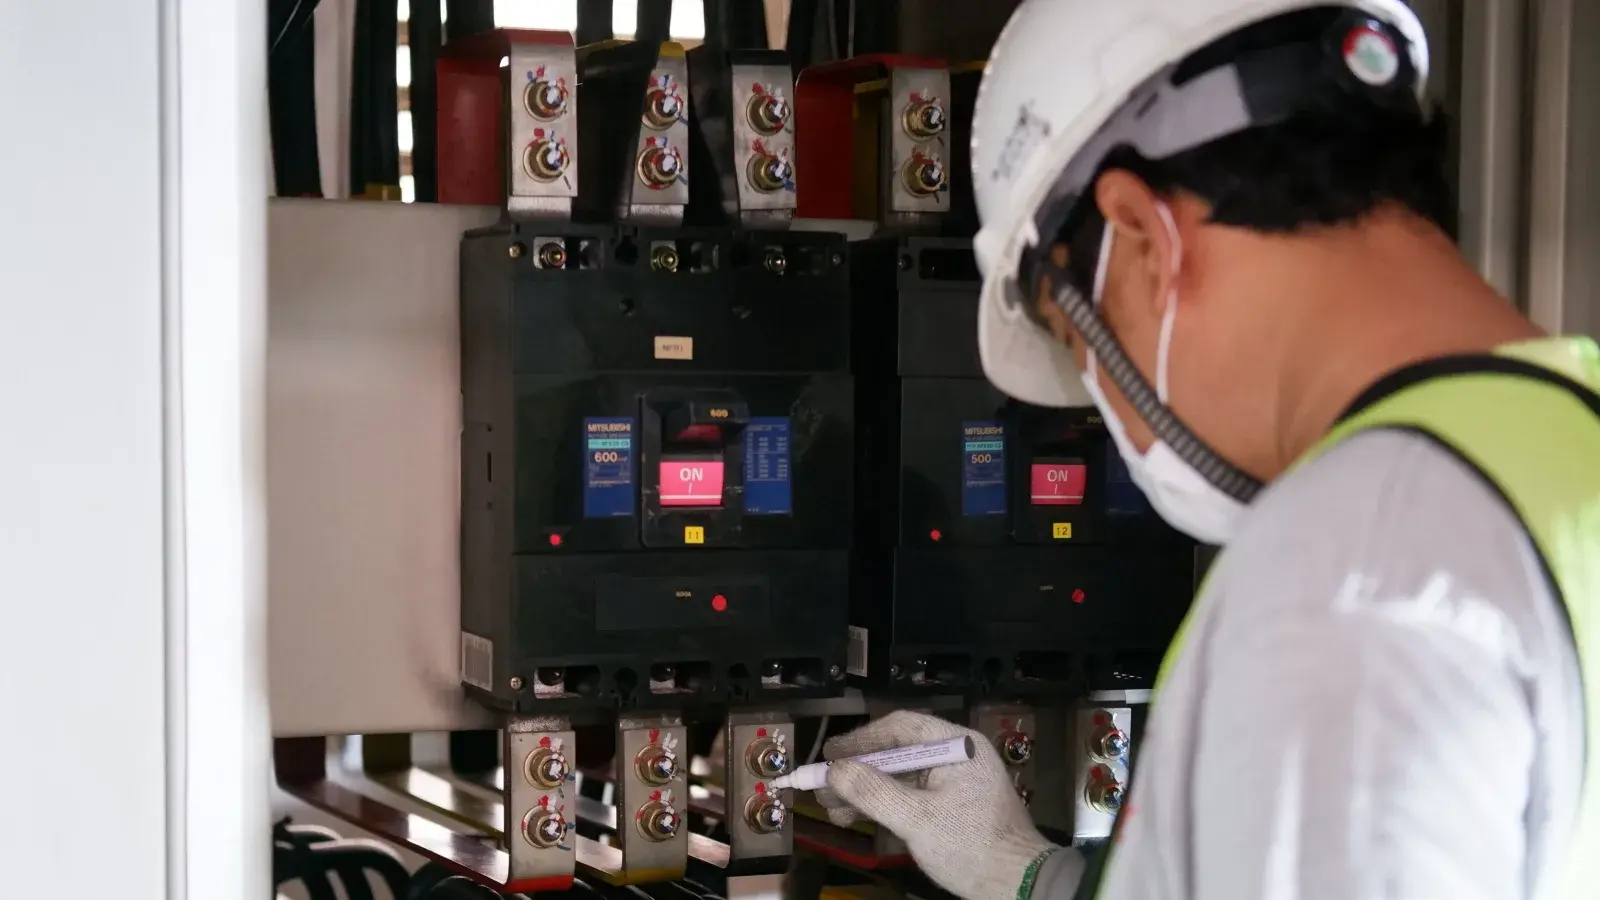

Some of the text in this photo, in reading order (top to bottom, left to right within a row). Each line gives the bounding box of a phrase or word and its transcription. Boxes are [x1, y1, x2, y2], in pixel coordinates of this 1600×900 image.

[588, 423, 631, 433] MITSUBISHI
[964, 427, 1004, 436] MITSUBISHI
[594, 451, 618, 463] 600
[971, 453, 992, 464] 500
[679, 467, 704, 482] ON
[1047, 469, 1069, 482] ON
[1056, 526, 1068, 536] 12
